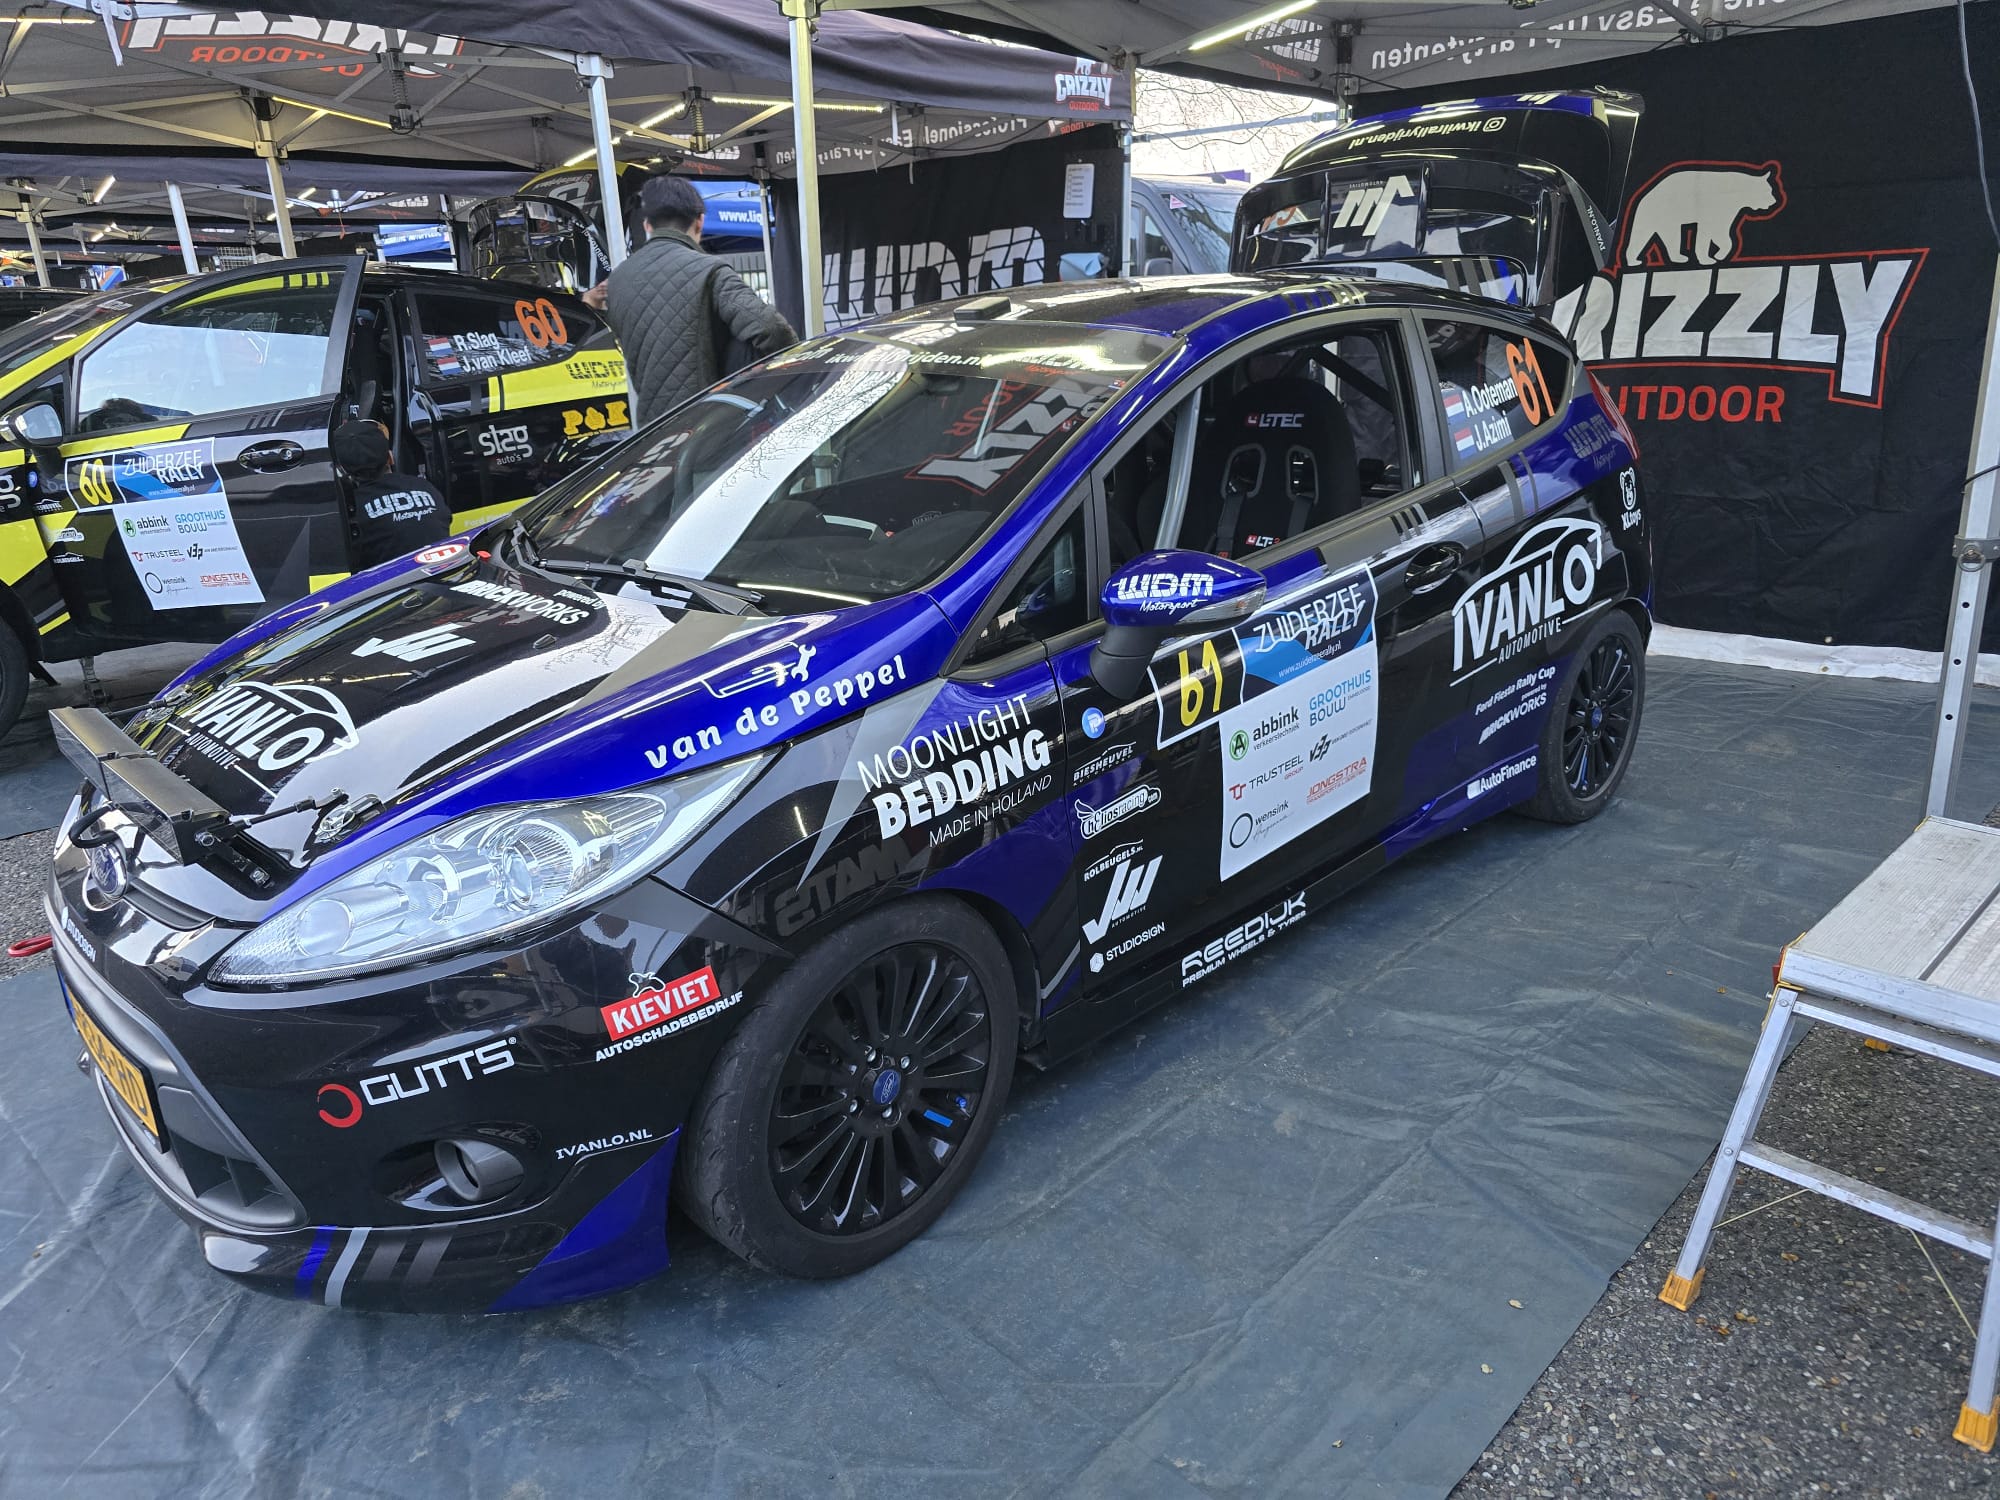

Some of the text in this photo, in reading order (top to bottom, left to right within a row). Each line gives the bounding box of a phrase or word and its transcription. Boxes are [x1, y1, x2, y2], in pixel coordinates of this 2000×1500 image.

[1055, 73, 1113, 106] GRIZZLY
[1348, 117, 1482, 150] ikwilrallyrijden.nl
[453, 331, 500, 352] R.Slag
[514, 298, 568, 349] 60
[1552, 259, 1913, 397] RIZZLY
[497, 345, 532, 366] Kleef
[1462, 377, 1519, 418] A.Ooteman
[1505, 337, 1556, 426] 61
[478, 425, 533, 458] slag
[1474, 410, 1512, 452] J.Azimi
[80, 458, 114, 506] 60
[122, 450, 203, 476] ZUIDERZEE
[157, 461, 205, 484] RALLY
[136, 515, 169, 529] abbink
[175, 510, 226, 524] GROOTHUIS
[178, 521, 208, 534] BOUW
[144, 549, 184, 560] TRUSTEEL
[200, 571, 250, 583] JONGSTRA
[1115, 572, 1215, 601] WDM
[1140, 599, 1209, 616] Motorsport
[1253, 582, 1362, 652] ZUIDERZEE
[1304, 599, 1366, 651] RALLY
[1453, 541, 1595, 672] IVANLO
[1498, 616, 1562, 665] AUTOMOTIVE
[1178, 640, 1223, 727] 61
[1309, 669, 1371, 712] GROOTHUIS
[1475, 666, 1556, 716] Ford Fiesta Rally Cup
[644, 654, 907, 769] van de Peppel
[1252, 705, 1300, 742] abbink
[1309, 697, 1346, 727] BOUW
[1479, 692, 1548, 745] BRICKWORKS
[185, 732, 241, 771] AUTOMOTIVE
[857, 693, 1032, 793] MOONLIGHT
[1073, 745, 1134, 782] BIESHEUVEL
[1249, 755, 1304, 790] TRUSTEEL
[1307, 756, 1367, 797] JONGSTRA
[1480, 755, 1538, 793] AutoFinance
[871, 728, 1052, 841] BEDDING
[929, 774, 1052, 848] MADE IN HOLLAND
[1254, 800, 1289, 826] wensink
[1106, 921, 1166, 961] STUDIOSIGN
[1181, 890, 1307, 977] REEDIJK
[1182, 910, 1307, 988] PREMIUM WHEELS & TYRES
[611, 974, 711, 1035] KIEVIET
[595, 990, 745, 1063] AUTOSCHADEBEDRIJF
[554, 1128, 653, 1161] IVANLO.NL
